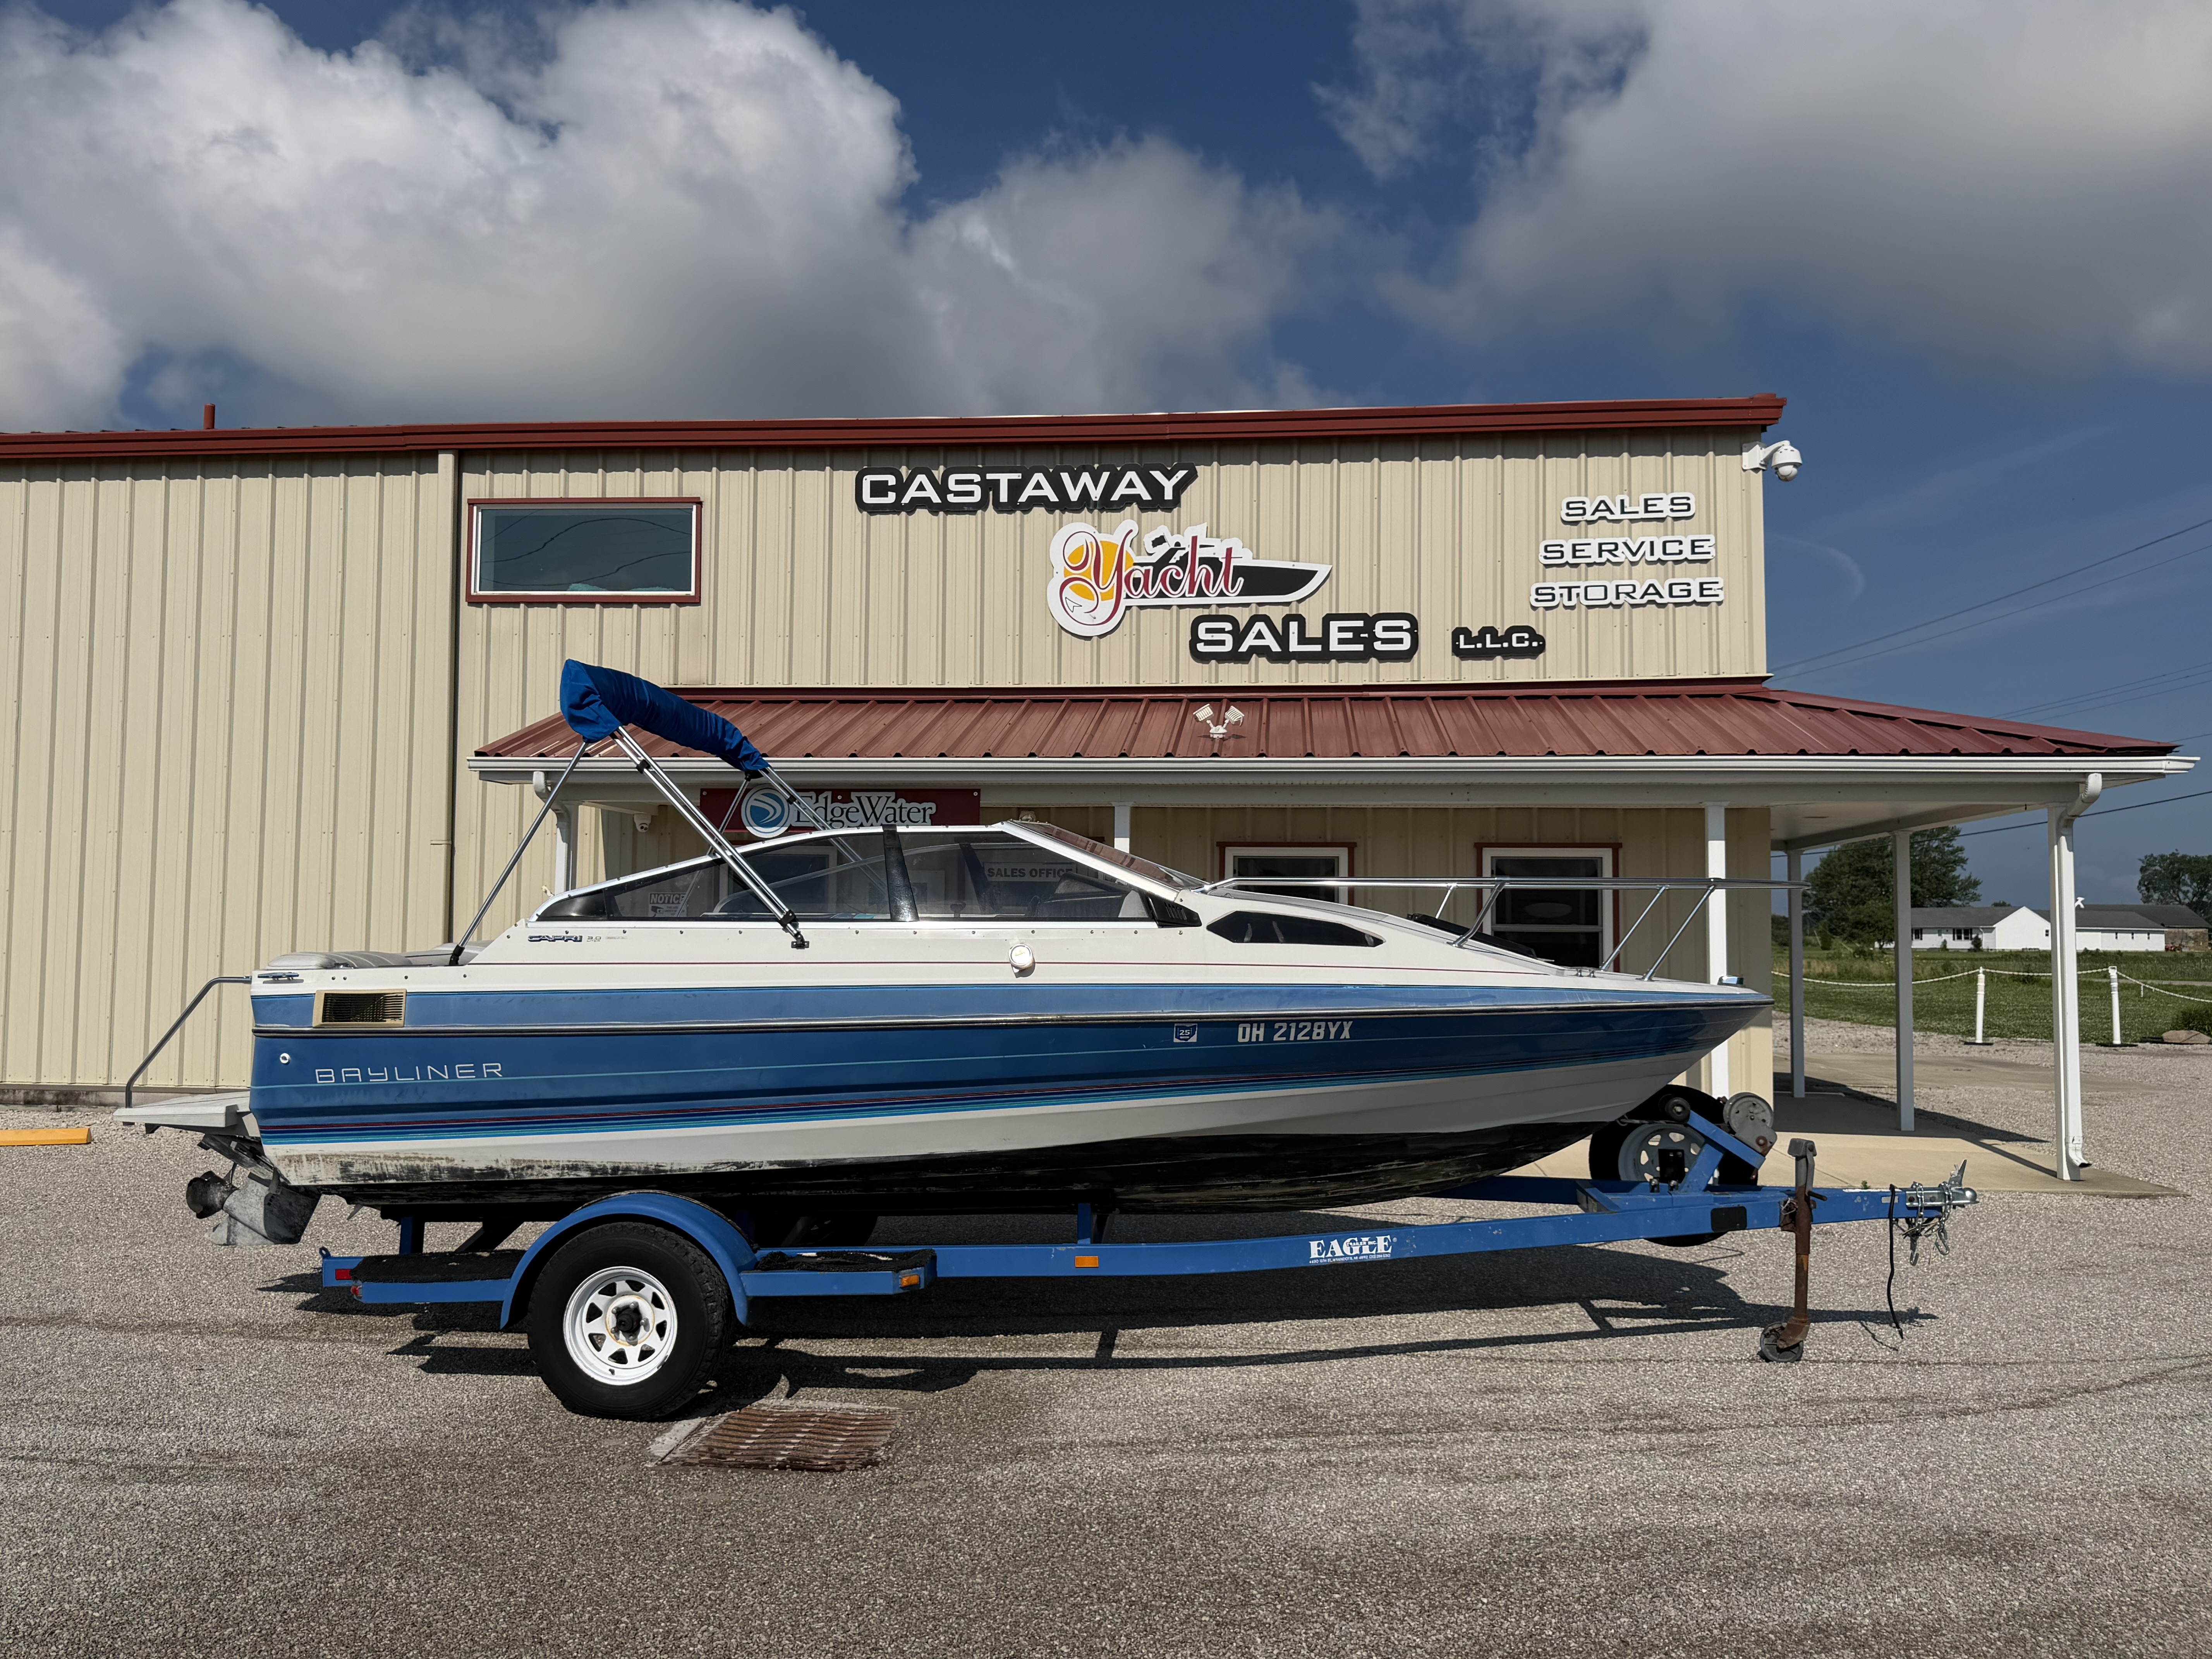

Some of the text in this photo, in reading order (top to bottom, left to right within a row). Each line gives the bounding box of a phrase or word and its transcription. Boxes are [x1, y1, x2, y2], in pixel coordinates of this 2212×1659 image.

[862, 470, 1189, 504] CASTAWAY
[1565, 496, 1691, 517] SALES
[1542, 538, 1711, 560] SERVICE
[1059, 529, 1244, 625] Yacht
[1534, 580, 1720, 602] STORAGE
[1195, 619, 1538, 653] SALES L.L.C.
[987, 867, 1026, 878] SALES
[1237, 1021, 1353, 1042] OH 2128YX
[315, 1062, 503, 1084] BAYLINER
[1309, 1235, 1392, 1259] EAGLE
